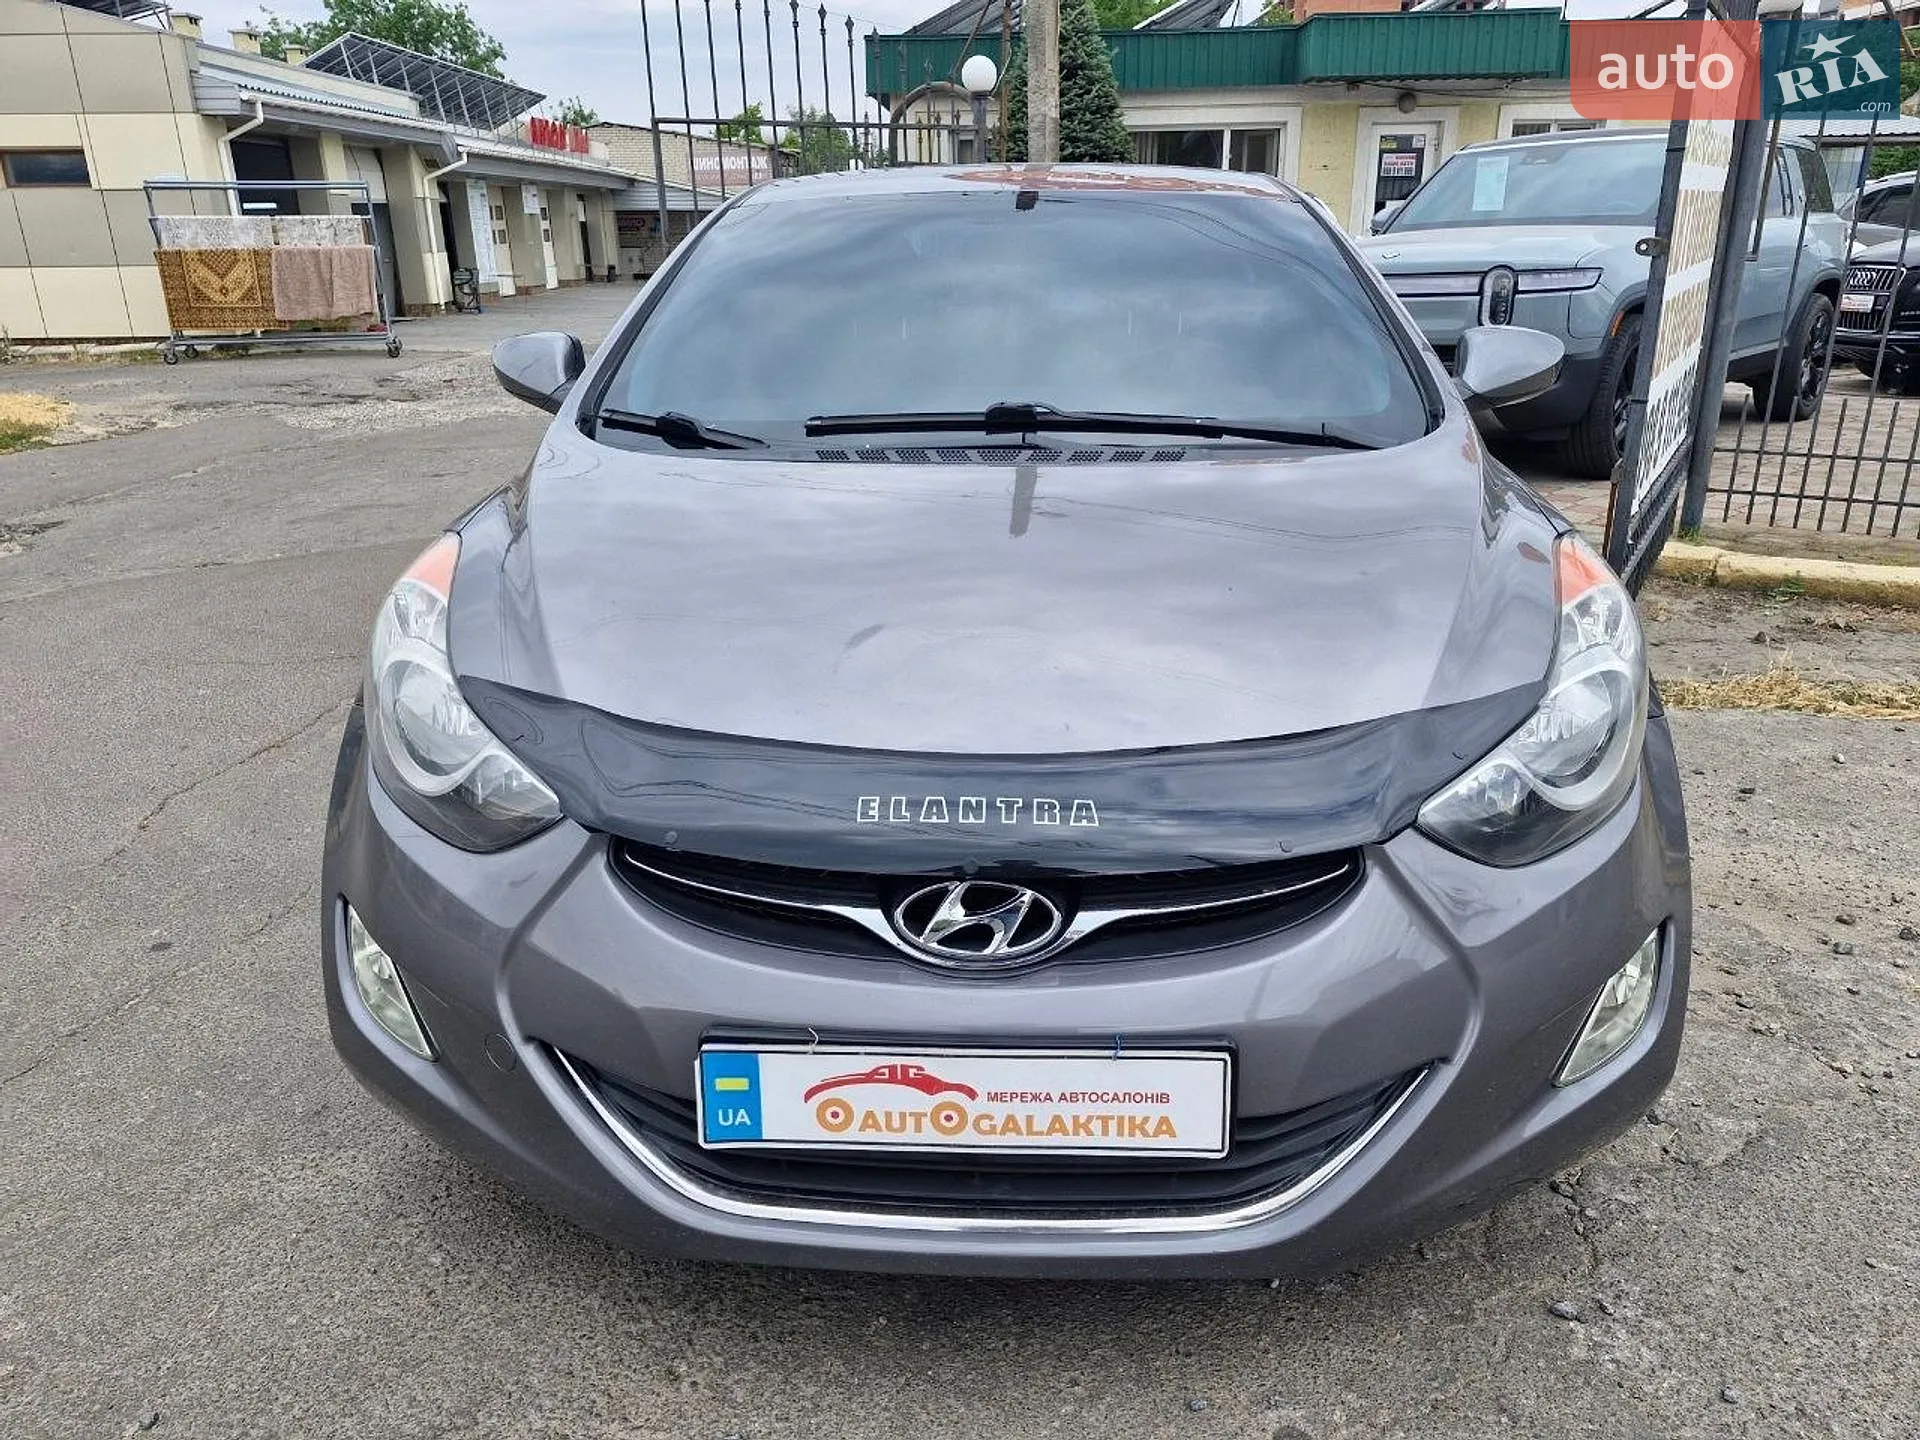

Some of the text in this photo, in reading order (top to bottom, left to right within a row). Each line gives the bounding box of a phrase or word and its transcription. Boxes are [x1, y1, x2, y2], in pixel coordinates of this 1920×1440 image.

[856, 796, 1099, 827] ELANTRA
[986, 1091, 1171, 1105] МЕРЕЖА АВТОСАЛОНІВ
[717, 1107, 752, 1127] UA
